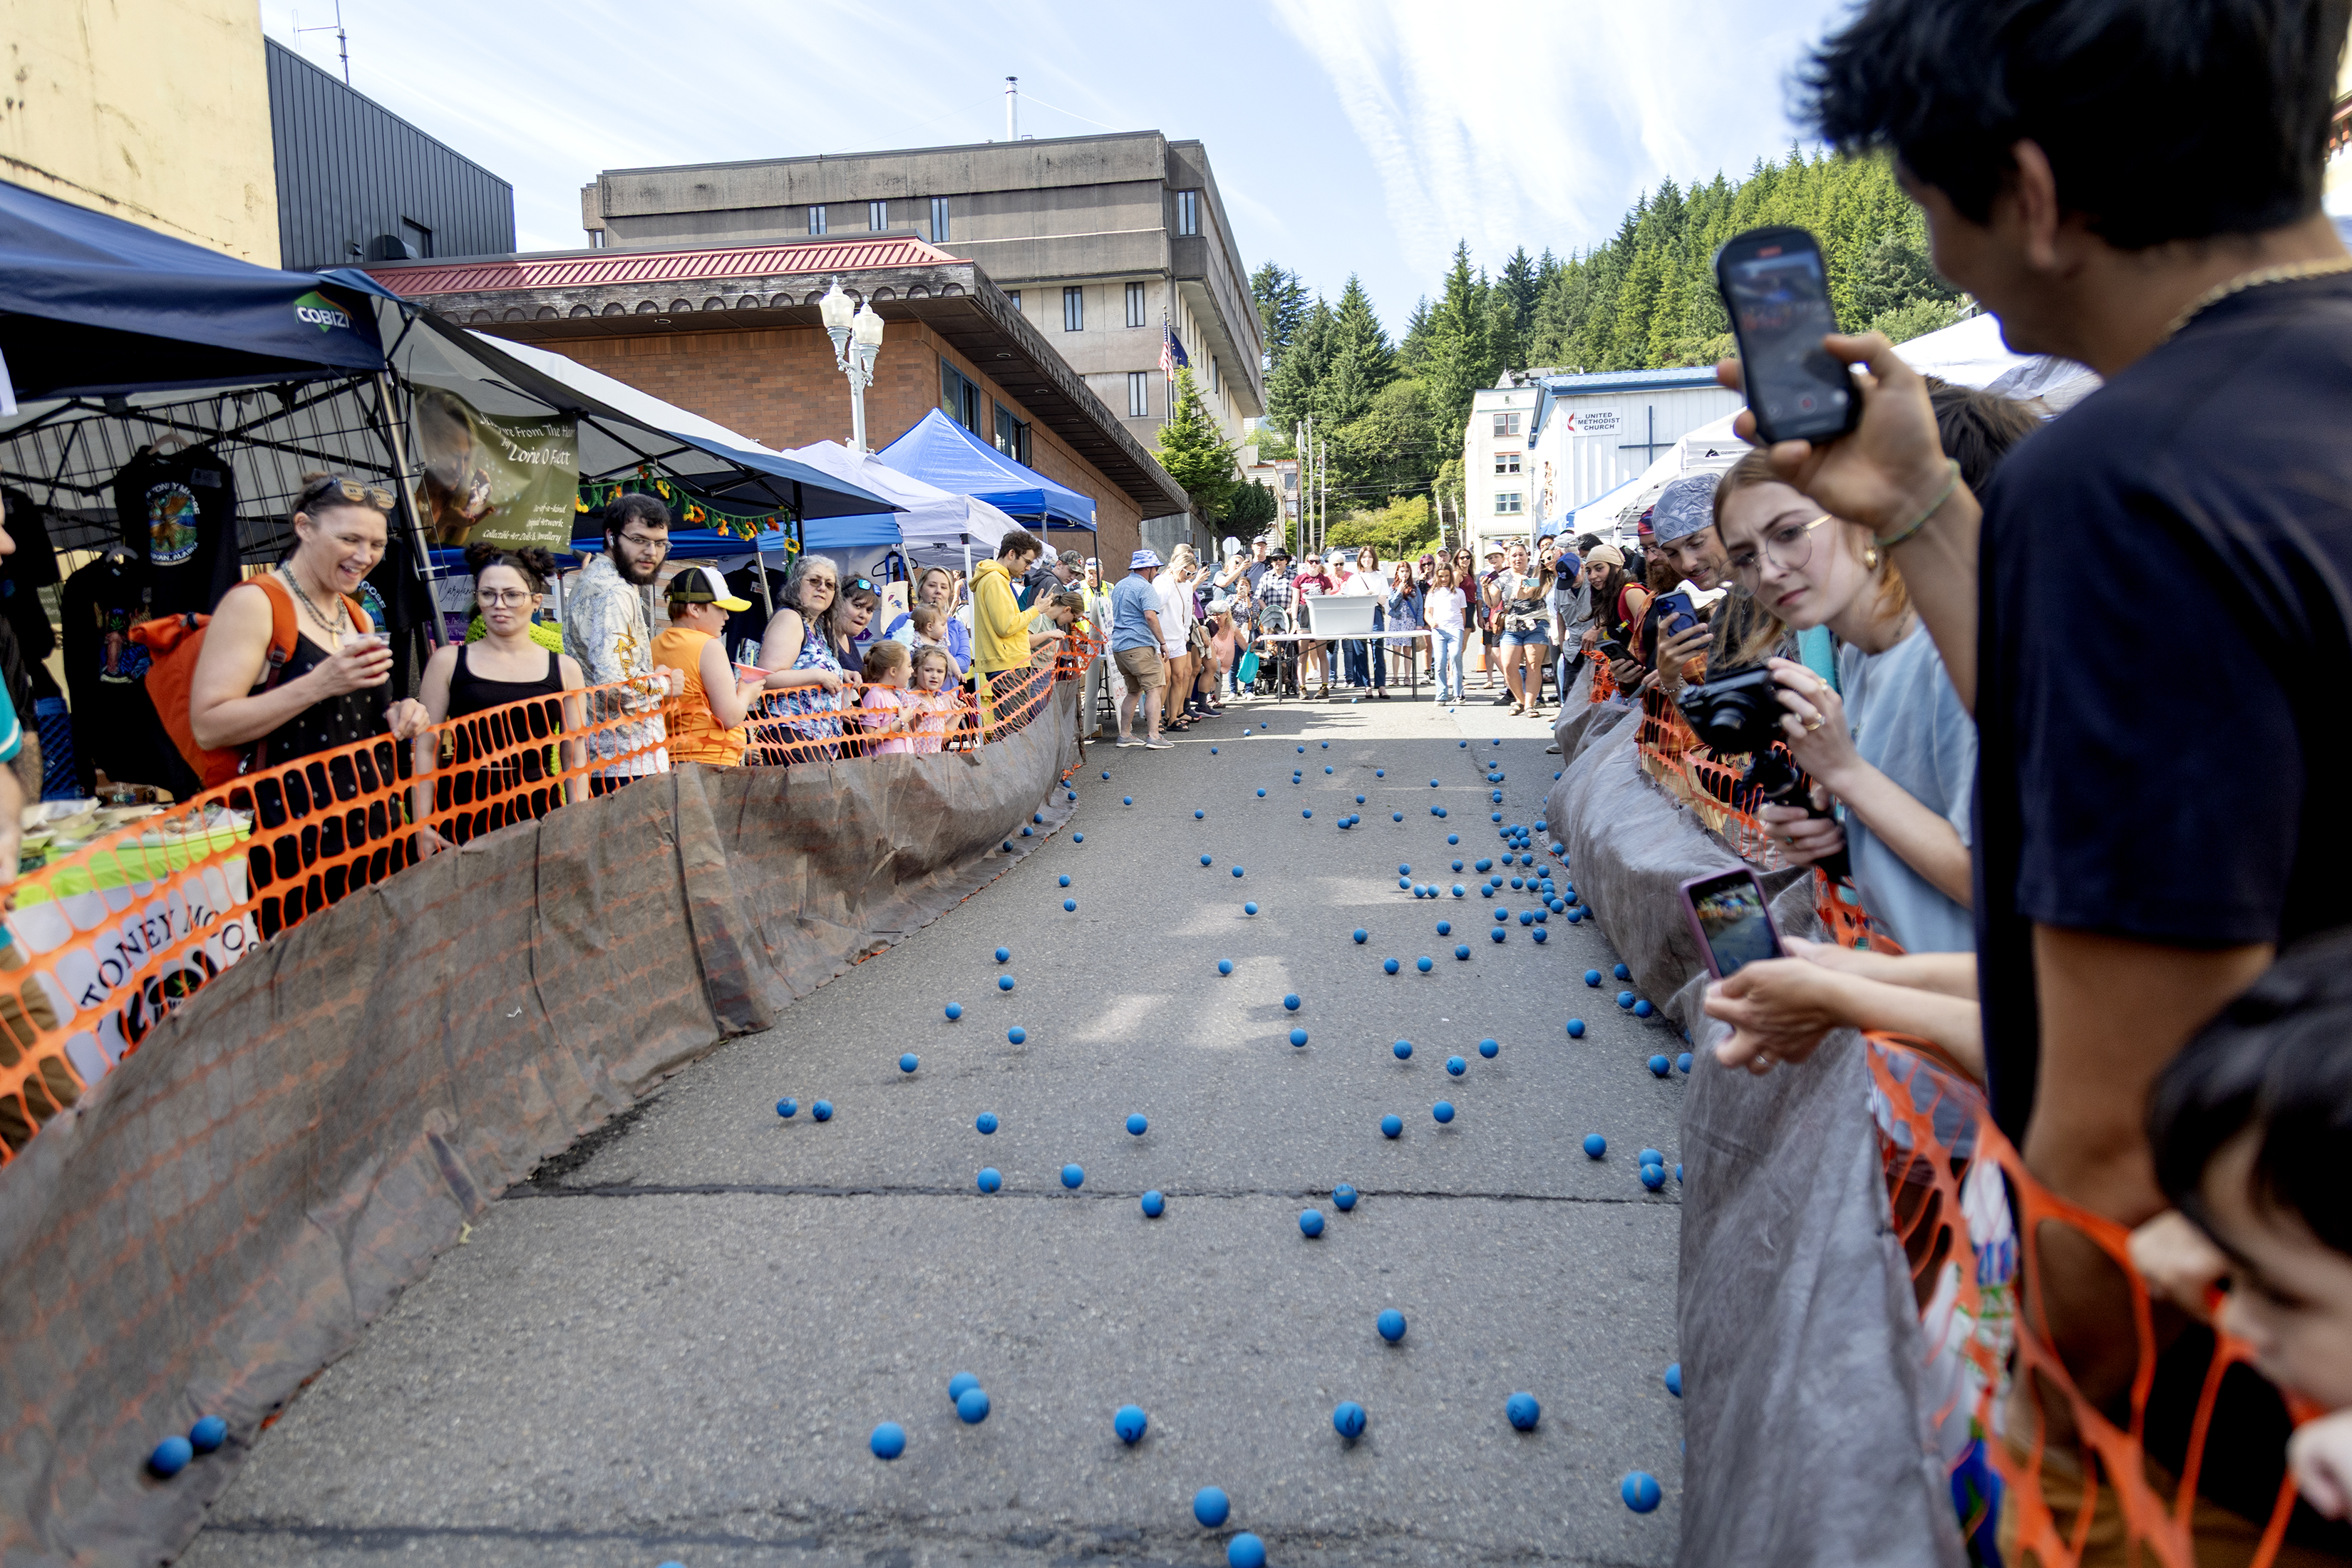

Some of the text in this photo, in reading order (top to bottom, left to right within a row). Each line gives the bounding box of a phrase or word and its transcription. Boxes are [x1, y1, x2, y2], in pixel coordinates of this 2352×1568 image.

[297, 306, 349, 328] COBIZI
[515, 426, 545, 438] From
[542, 423, 560, 437] The
[500, 438, 511, 450] by
[507, 443, 540, 464] Lorie
[483, 529, 510, 540] Collectible
[359, 580, 387, 609] OOSE
[81, 909, 175, 1033] TONEY
